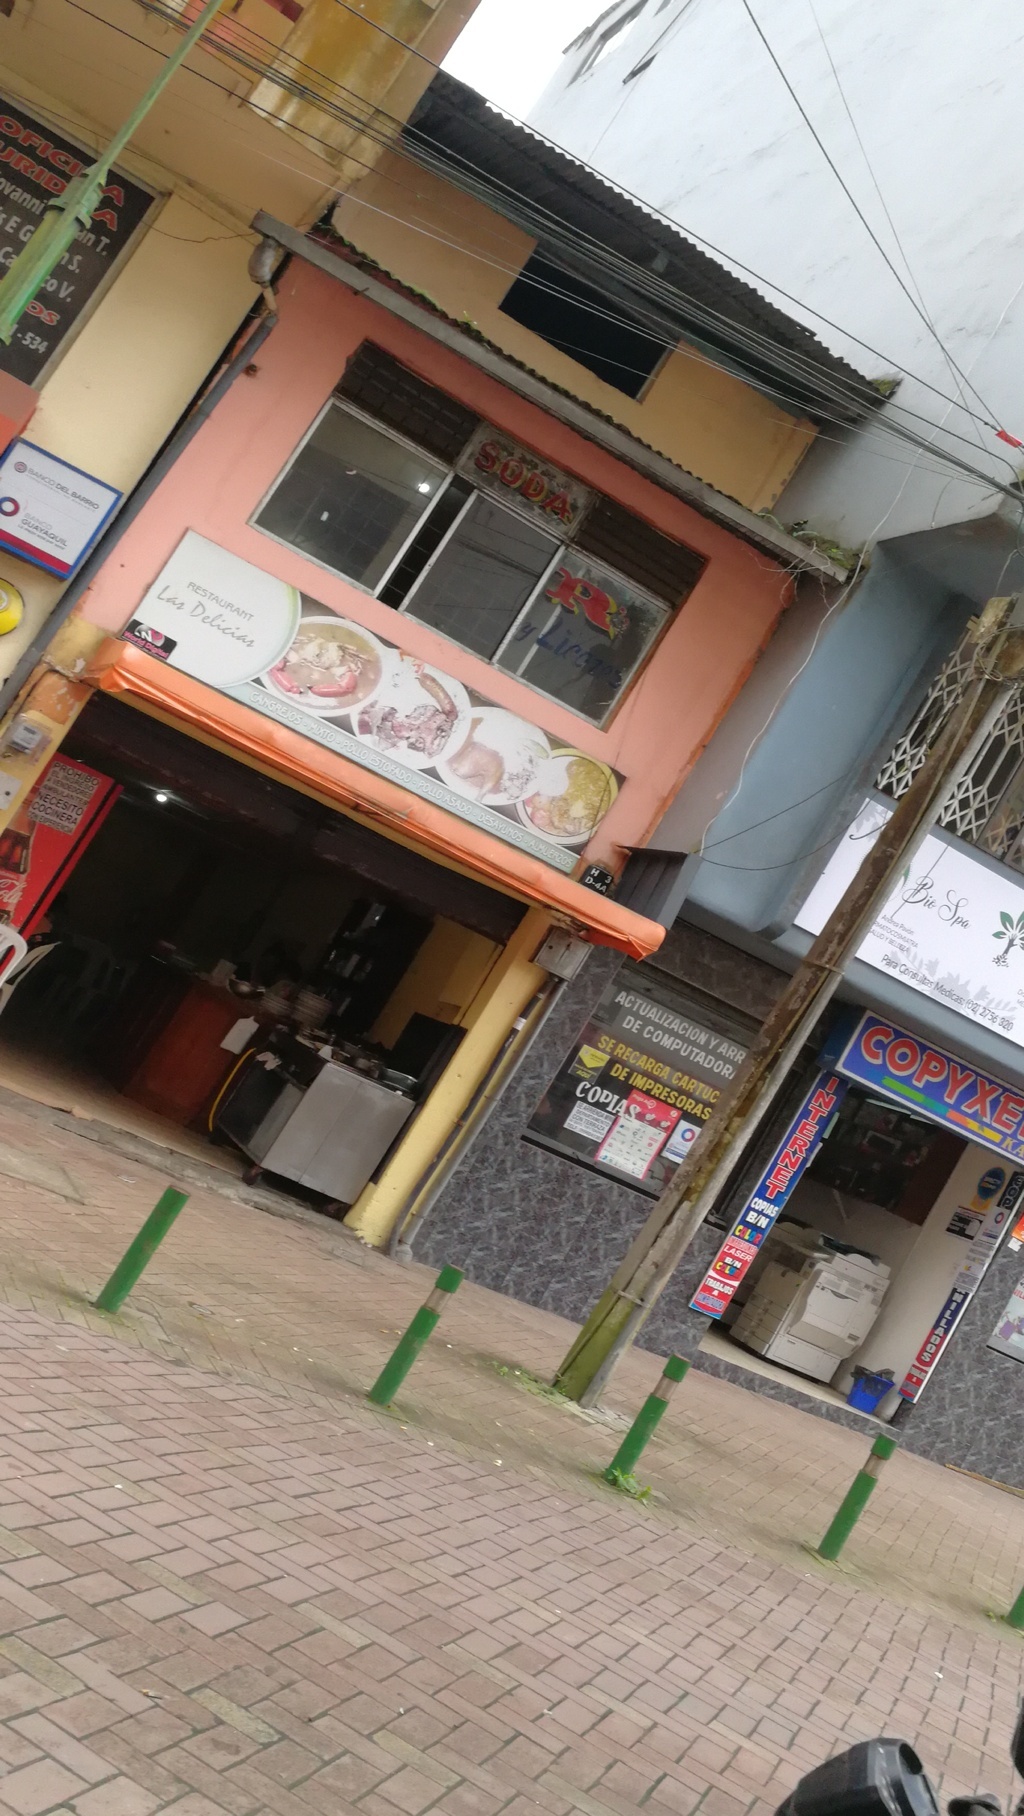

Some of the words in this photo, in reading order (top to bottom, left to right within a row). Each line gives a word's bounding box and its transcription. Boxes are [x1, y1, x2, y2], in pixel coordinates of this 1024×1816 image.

[0, 115, 124, 207] OFICIA
[55, 483, 70, 496] DEL
[70, 491, 100, 510] BARRIO
[474, 442, 574, 527] SODA
[20, 518, 68, 547] GUAYAQUIL
[157, 585, 184, 610] Las
[190, 600, 254, 648] Delicias
[187, 581, 254, 622] RESTAURANT
[144, 640, 169, 659] Digital
[250, 691, 303, 724] CANGREJOS
[307, 722, 336, 743] MIXTO
[343, 740, 370, 760] POLLO
[368, 753, 413, 783] ESTOFADO
[416, 779, 443, 799] POLLO
[442, 794, 473, 815] ASADO
[477, 813, 525, 843] DESAYUNOS
[527, 838, 575, 868] ALMUERZOS
[32, 801, 78, 825] COCINERA
[38, 792, 83, 816] NECESITO
[585, 876, 608, 893] D-4A
[591, 868, 600, 877] H
[605, 876, 613, 884] 3
[902, 876, 938, 909] Bio
[937, 889, 972, 930] Spa
[881, 954, 899, 969] Para
[898, 963, 934, 988] Consultas
[977, 1006, 999, 1023] 2756
[998, 1017, 1014, 1032] 320
[615, 990, 709, 1048] ACTUALIZACION
[707, 1036, 719, 1050] Y
[718, 1043, 748, 1064] ARR
[622, 1015, 645, 1034] DE
[597, 1035, 616, 1053] SE
[615, 1042, 671, 1080] RECARGA
[671, 1070, 722, 1104] CARTUC
[861, 1025, 1024, 1140] COPYXE
[575, 1081, 642, 1119] COPIAS
[609, 1063, 630, 1082] DE
[628, 1071, 713, 1121] IMPRESORAS
[765, 1077, 840, 1200] INTERNET
[745, 1211, 770, 1228] B/N
[750, 1197, 779, 1217] COPIAS
[735, 1225, 762, 1244] COLOR
[724, 1245, 753, 1262] LASER
[724, 1257, 742, 1269] B/N
